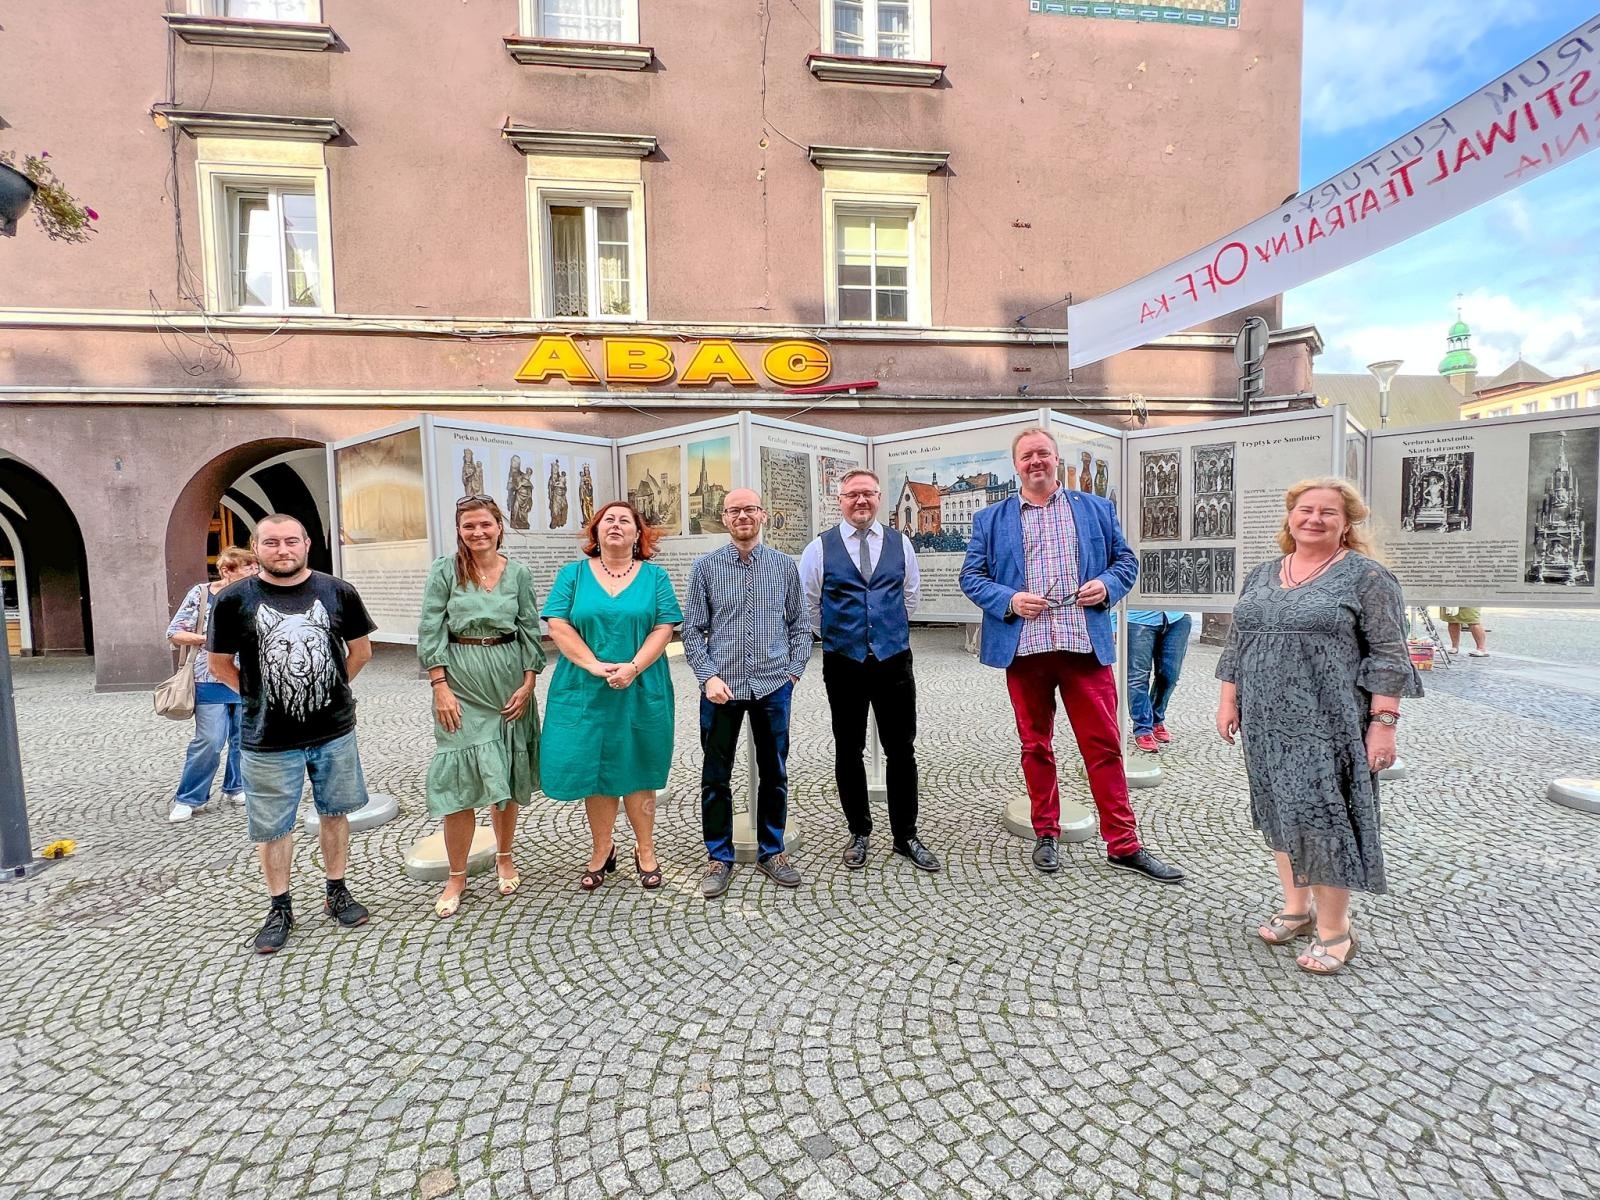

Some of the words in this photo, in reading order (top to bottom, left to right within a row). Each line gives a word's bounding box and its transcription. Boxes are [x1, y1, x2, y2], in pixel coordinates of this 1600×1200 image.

[514, 335, 832, 387] ABAC
[481, 435, 513, 445] Madonna
[1241, 439, 1272, 449] Tryptyk
[1283, 434, 1321, 444] Smolnicy
[1402, 438, 1435, 447] Srebrna
[1407, 446, 1432, 455] Skarb
